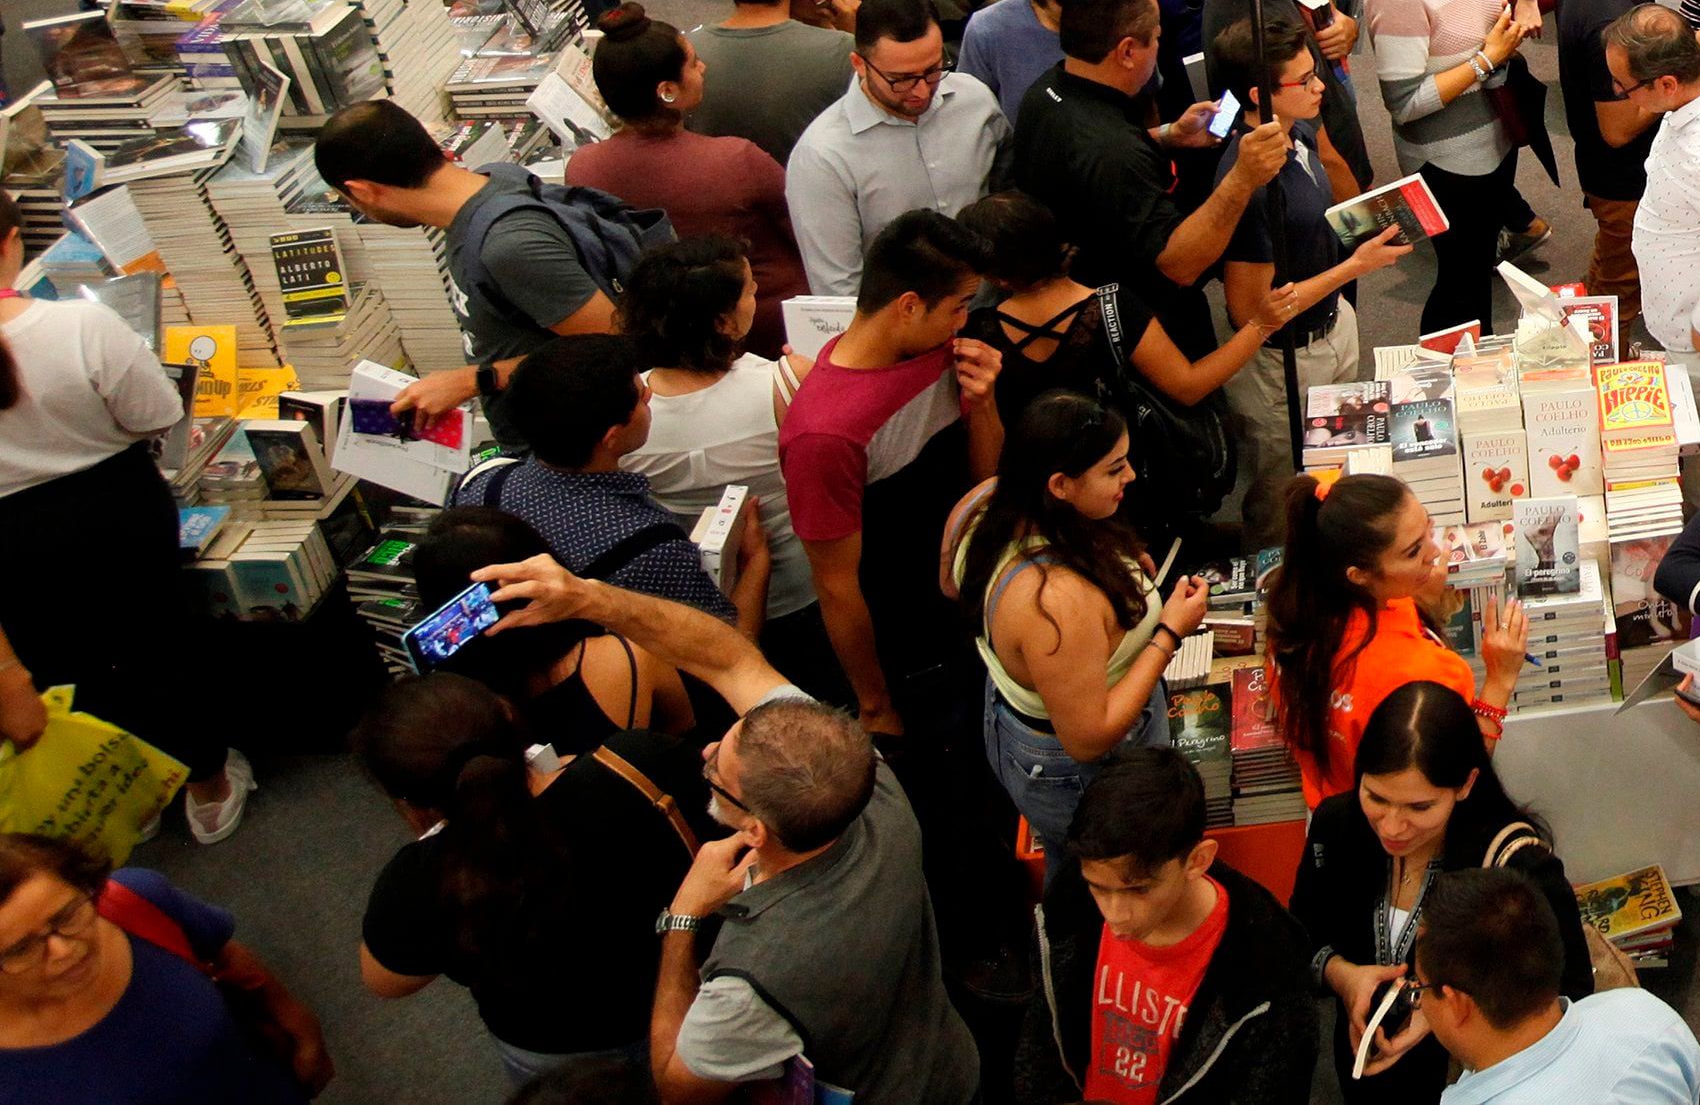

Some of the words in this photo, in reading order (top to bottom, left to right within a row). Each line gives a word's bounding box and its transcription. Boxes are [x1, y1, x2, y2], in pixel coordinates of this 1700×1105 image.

[275, 245, 336, 259] LATITUDES
[280, 260, 331, 274] ALBERTO
[283, 274, 310, 284] LATI
[1402, 401, 1442, 412] PAULO
[1541, 399, 1582, 412] PAULO
[1603, 387, 1664, 414] HIPPIE
[1396, 407, 1447, 418] COELHO
[1535, 409, 1588, 423] COELHO
[1376, 417, 1385, 442] PAULO
[1540, 425, 1586, 438] Adulterio
[1476, 438, 1515, 449] PAULO
[1471, 446, 1521, 458] COELHO
[1525, 505, 1565, 516] PAULO
[1520, 515, 1571, 526] COELHO
[1534, 567, 1570, 579] peregrino
[1178, 734, 1226, 749] Peregrino
[1646, 870, 1672, 915] STEPHEN
[1115, 1046, 1147, 1082] 22
